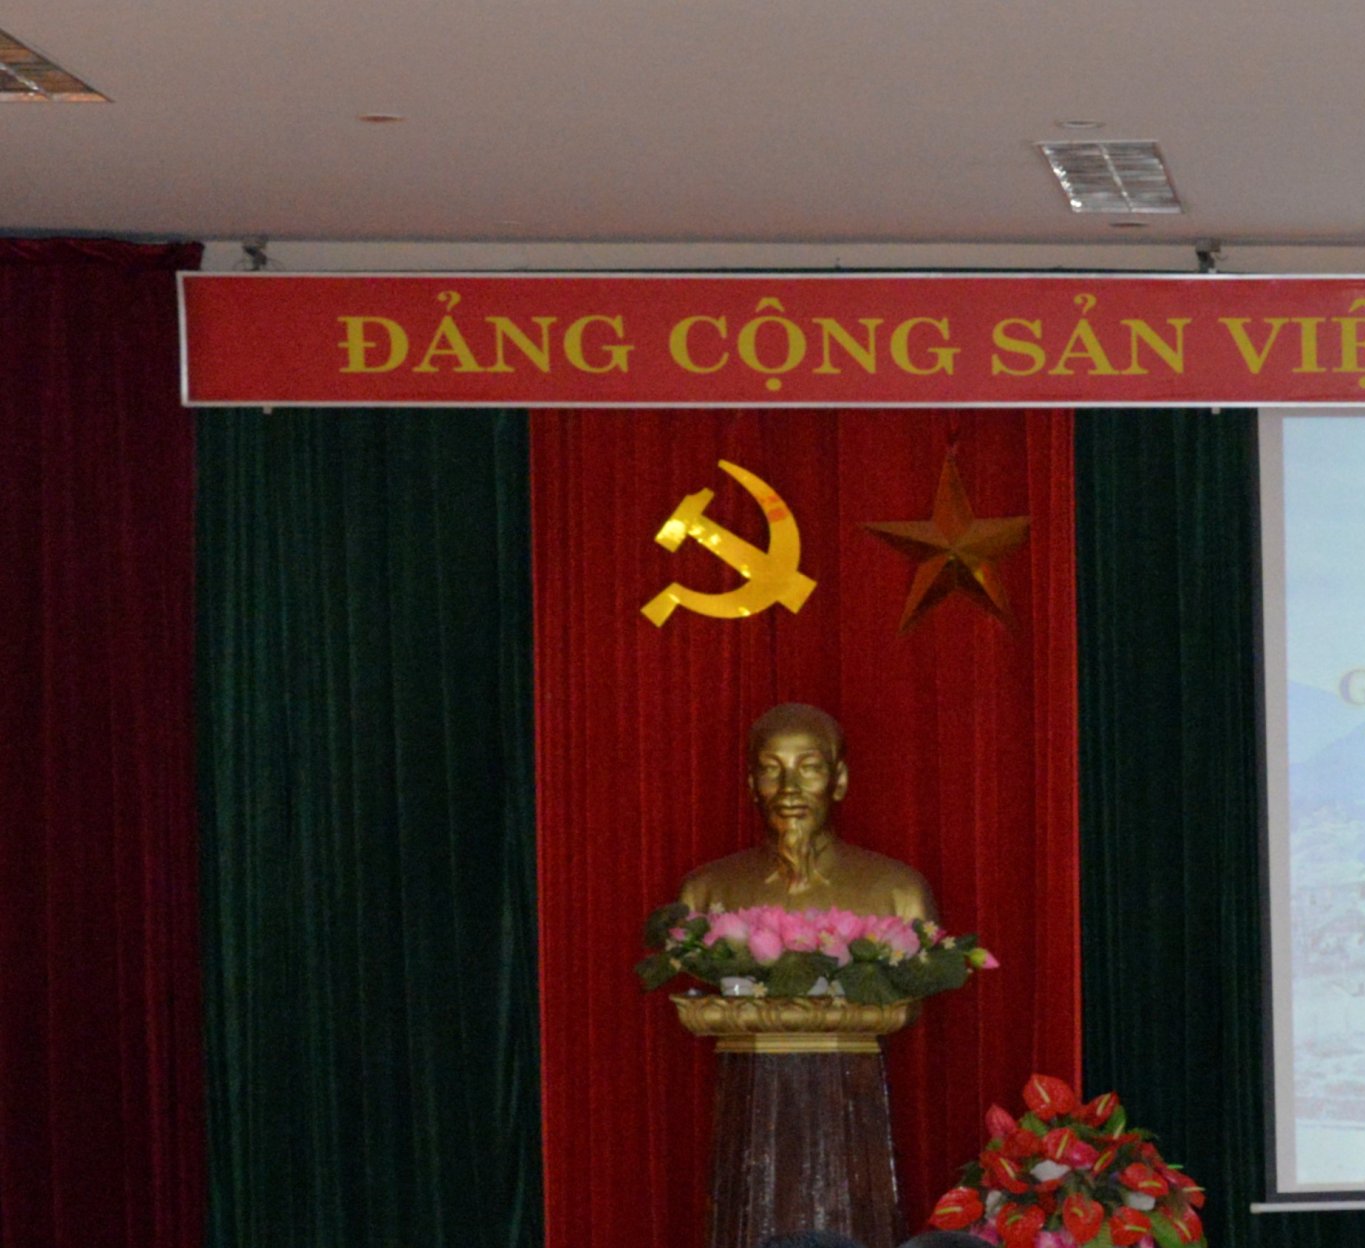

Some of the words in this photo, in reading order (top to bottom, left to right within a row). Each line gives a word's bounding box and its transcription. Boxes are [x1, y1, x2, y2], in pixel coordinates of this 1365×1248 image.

[338, 290, 636, 374] ĐẢNG
[668, 297, 961, 391] CỘNG
[990, 294, 1192, 376] SẢN
